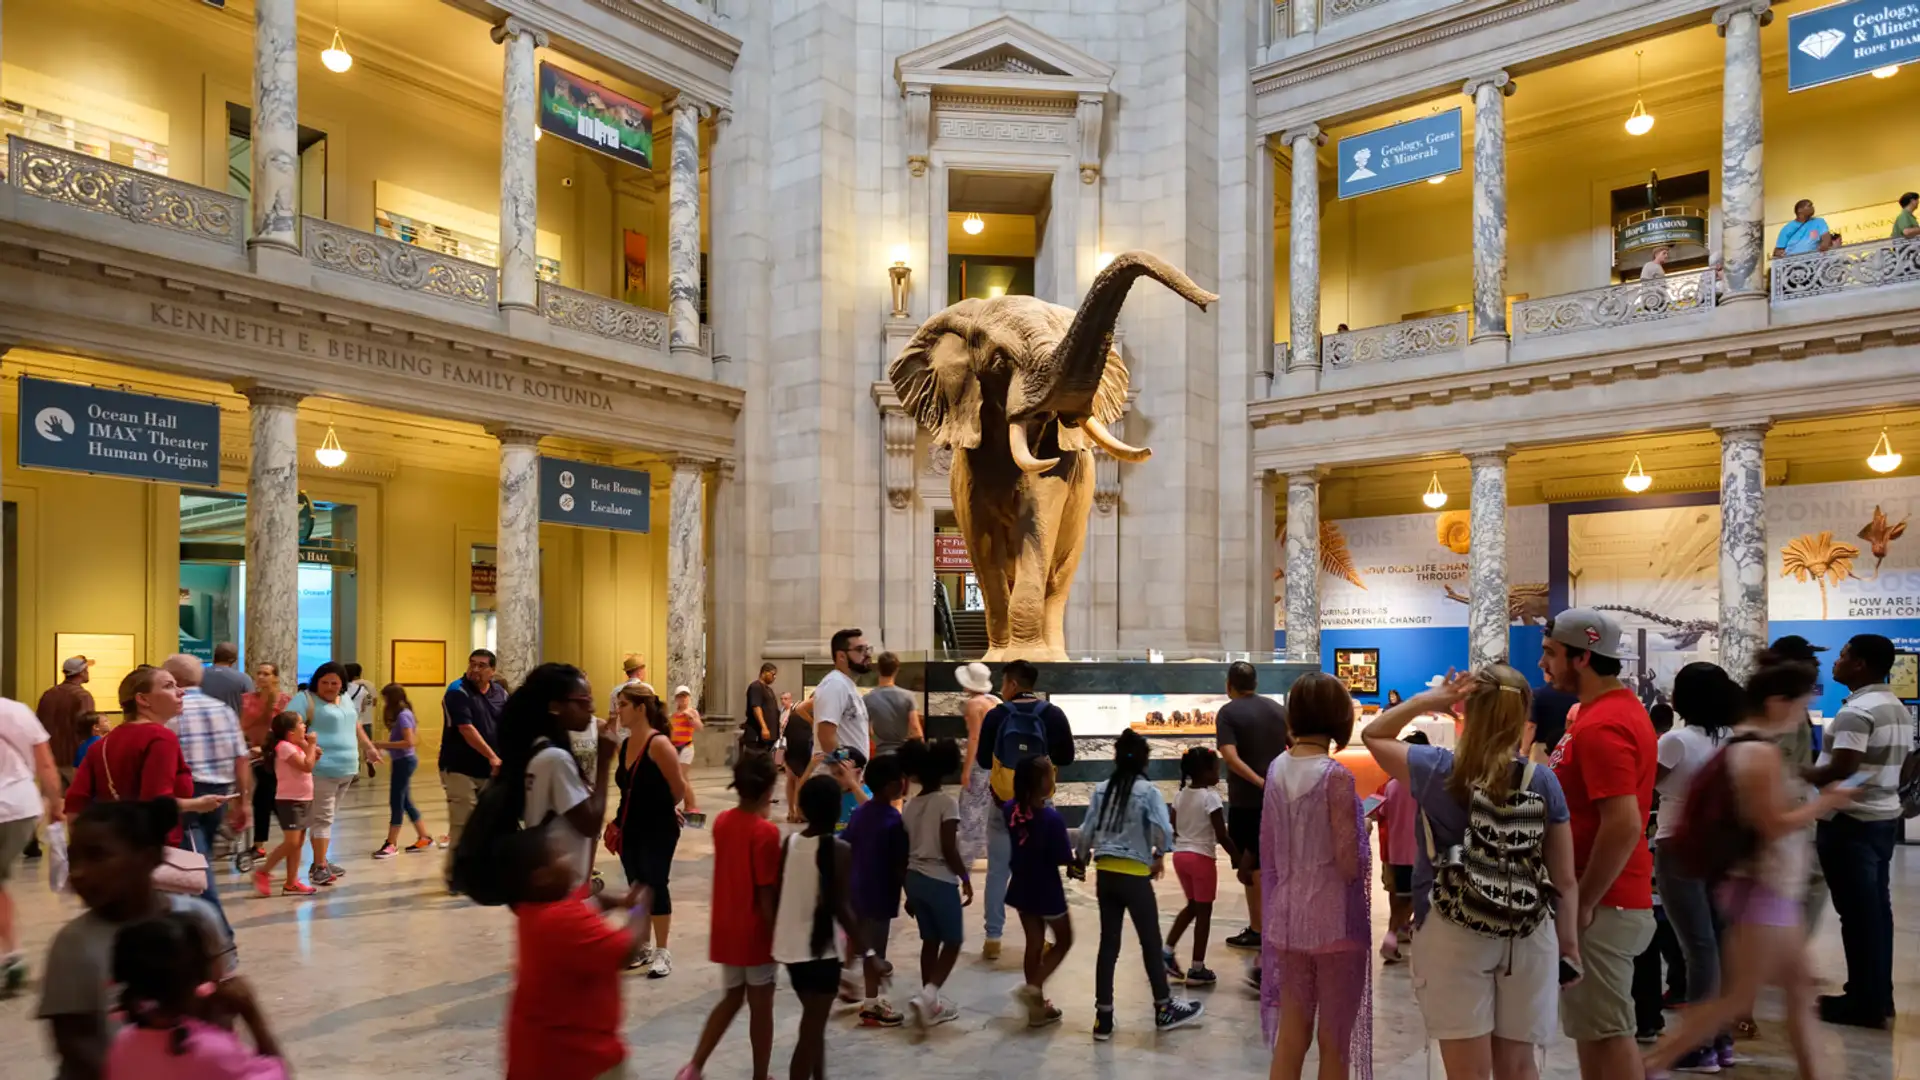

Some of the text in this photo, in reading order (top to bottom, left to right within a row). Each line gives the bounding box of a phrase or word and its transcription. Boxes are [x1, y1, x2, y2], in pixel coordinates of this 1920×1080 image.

[1853, 4, 1919, 27] Geology,
[1853, 29, 1868, 43] &
[1854, 43, 1888, 59] HOPE
[1381, 131, 1455, 156] Geology, Gems
[1381, 146, 1439, 169] & Minerals
[1625, 219, 1688, 238] HOPE DIAMOND
[150, 302, 614, 412] KENNETH E. BEHRING FAMILY ROTUNDA
[87, 404, 177, 429] Ocean Hall
[147, 430, 209, 451] Theater
[88, 441, 209, 470] Human Origins
[591, 478, 642, 496] Rest Rooms
[590, 500, 632, 516] Escalator
[306, 552, 329, 562] HALL
[1388, 565, 1414, 574] DOES
[1416, 564, 1437, 572] LIFE
[1440, 562, 1469, 571] CHAN
[1849, 598, 1882, 606] HOW
[1885, 596, 1912, 605] ARE
[1321, 615, 1432, 626] NVIRONMENTAL CHANGE?
[1849, 607, 1891, 616] EARTH
